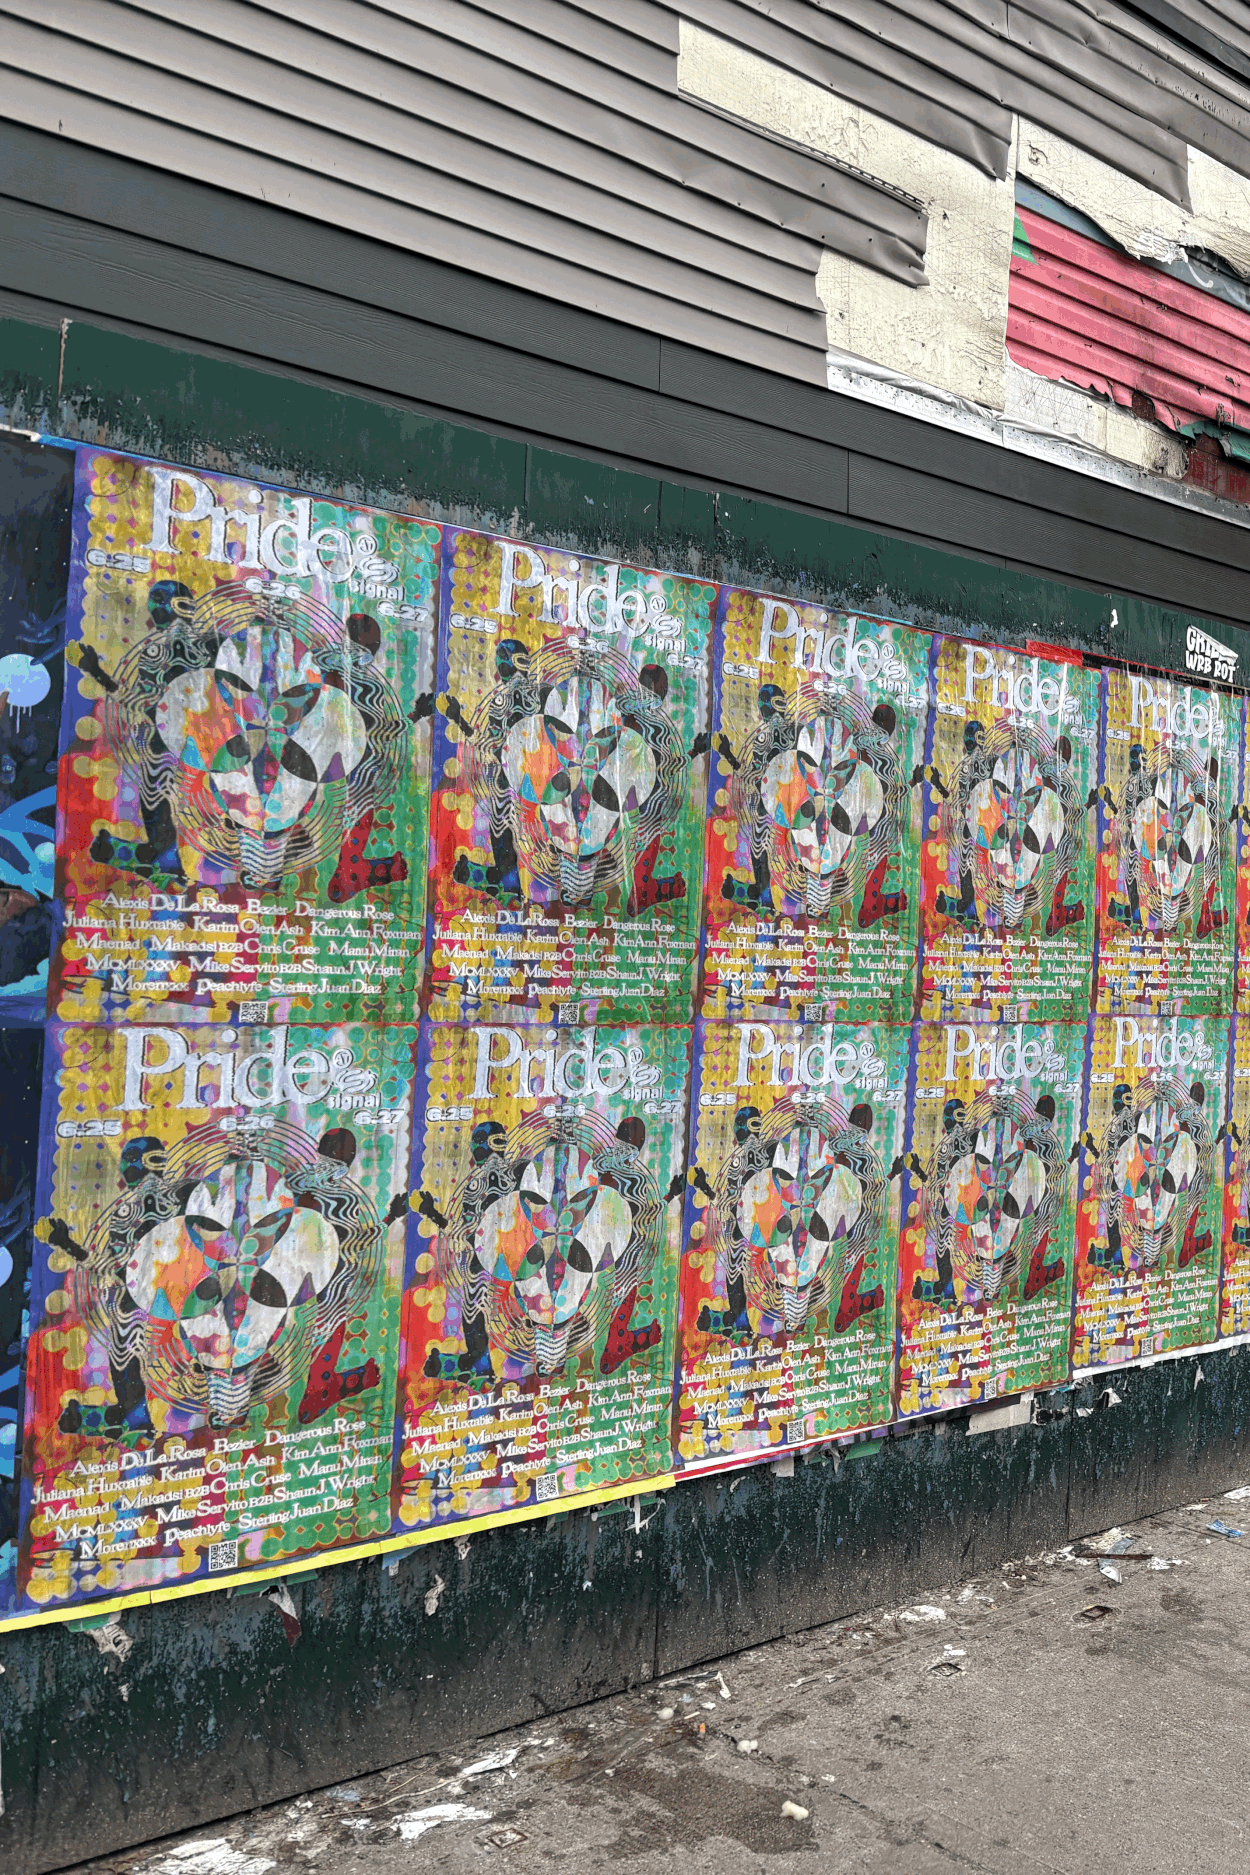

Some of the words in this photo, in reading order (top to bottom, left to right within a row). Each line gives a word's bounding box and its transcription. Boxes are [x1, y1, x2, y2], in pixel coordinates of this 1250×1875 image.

[141, 466, 354, 584] Pride
[351, 580, 405, 601] signal
[490, 541, 650, 638] Pride
[753, 597, 882, 682] Pride
[961, 643, 1061, 718] Pride
[1126, 675, 1211, 738] Pride
[112, 1024, 333, 1112] Pride
[466, 1026, 629, 1098] Pride
[731, 1023, 858, 1087] Pride
[940, 1024, 1044, 1081] Pride
[1110, 1016, 1196, 1068] Pride
[327, 1093, 382, 1109] signal
[623, 1086, 664, 1100] signal
[30, 1486, 85, 1505] Juliana
[160, 1466, 206, 1484] Karim
[244, 1454, 276, 1470] Ash
[282, 1446, 311, 1463] Kim
[311, 1442, 342, 1457] Ann
[342, 1434, 393, 1450] Foxman
[70, 1460, 118, 1477] Alexis
[144, 1448, 167, 1466] La
[168, 1445, 206, 1462] Rosa
[214, 1437, 256, 1454] Bezier
[264, 1426, 332, 1446] Dangerous
[334, 1418, 366, 1434] Rose
[44, 1502, 111, 1523] Maenad
[118, 1492, 184, 1511] Makadsi
[185, 1486, 210, 1498] B2B
[210, 1477, 250, 1493] Chris
[251, 1470, 292, 1487] Cruse
[298, 1460, 341, 1478] Manu
[155, 1504, 197, 1524] Mike
[197, 1498, 248, 1516] Servito
[249, 1495, 275, 1507] B2B
[274, 1486, 319, 1503] Shaun
[318, 1479, 328, 1495] J.
[328, 1472, 375, 1492] Wright
[238, 1510, 291, 1530] Sterling
[290, 1504, 322, 1520] Juan
[322, 1496, 354, 1512] Diaz
